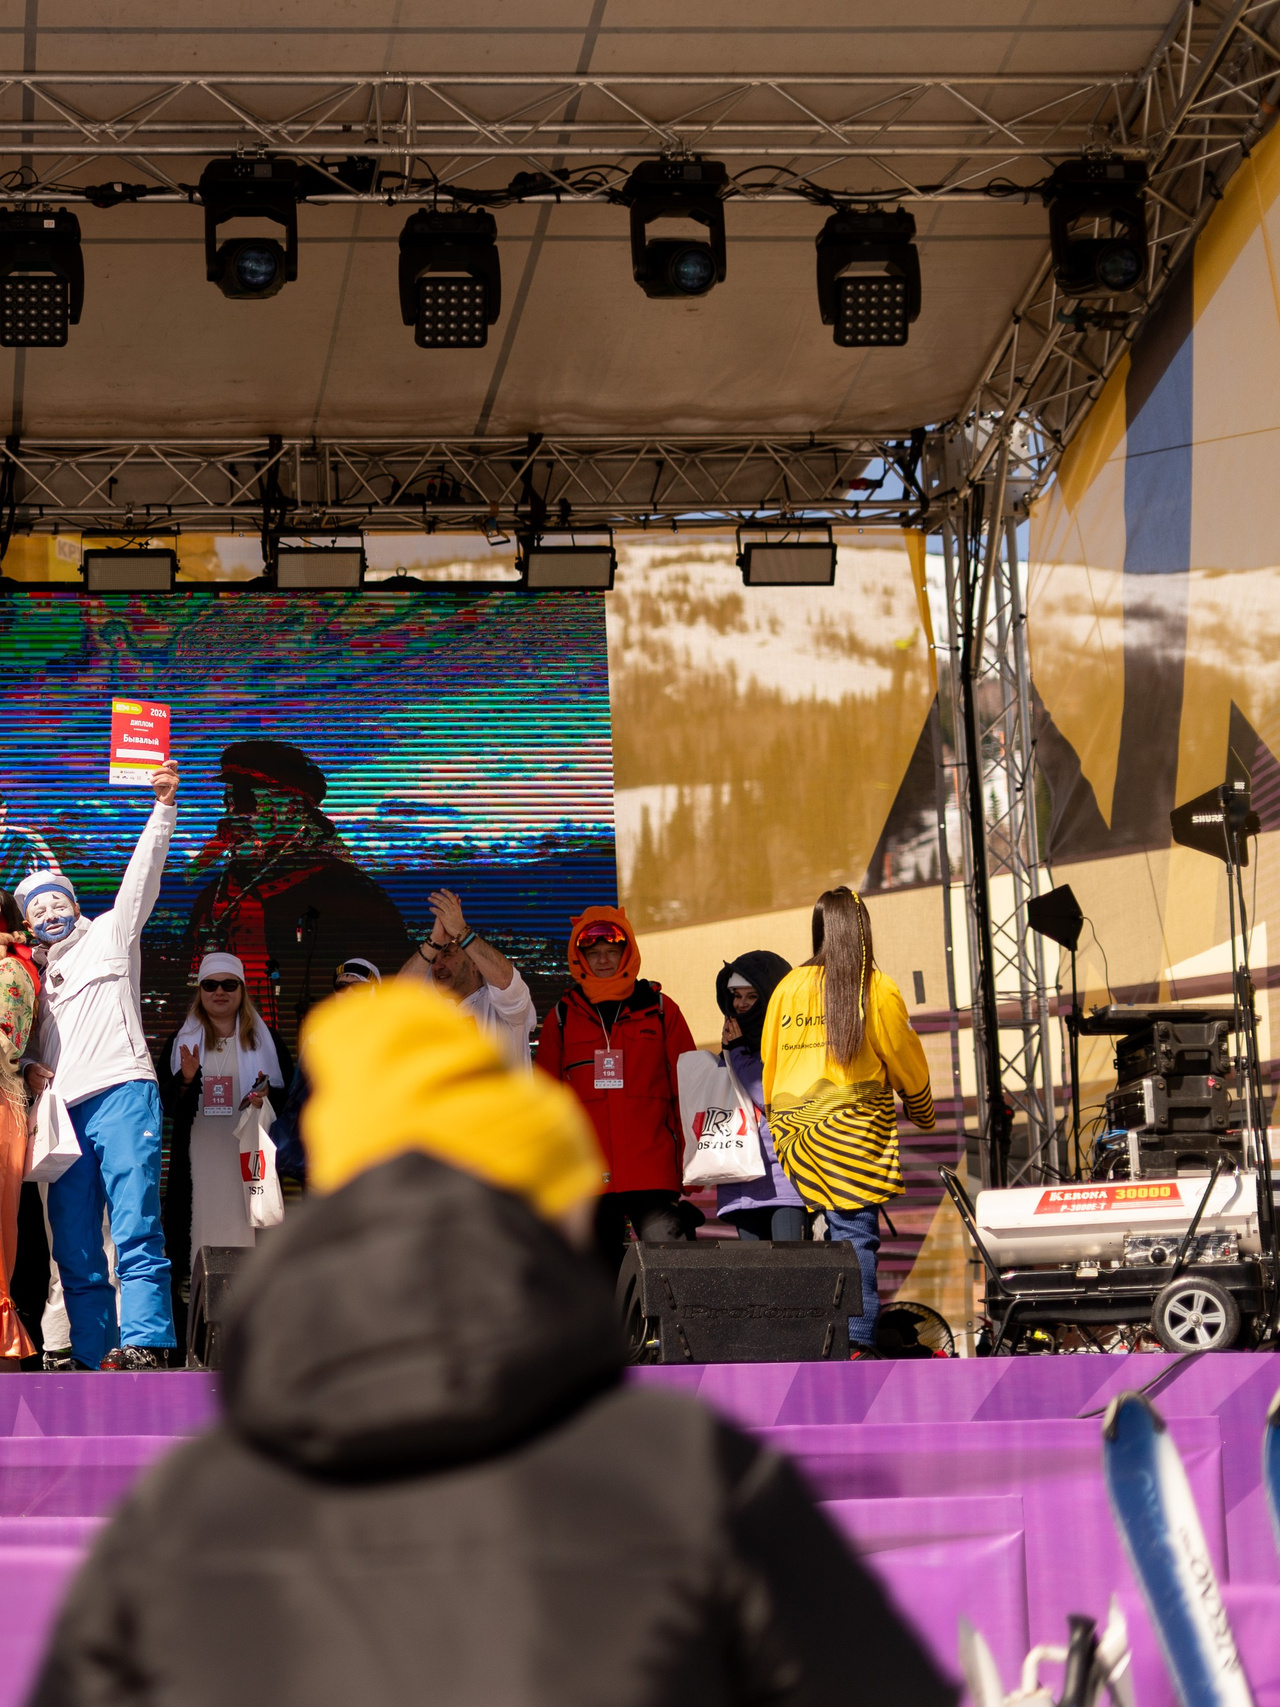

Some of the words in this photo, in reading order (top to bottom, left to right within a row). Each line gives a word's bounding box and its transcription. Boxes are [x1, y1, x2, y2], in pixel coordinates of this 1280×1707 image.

[150, 708, 167, 718] 2024
[123, 733, 160, 746] Бывалый
[1191, 814, 1224, 824] SHURE
[795, 1013, 827, 1027] била
[1049, 1190, 1109, 1202] KERONA
[1114, 1186, 1172, 1200] 30000
[681, 1304, 827, 1319] ProTone
